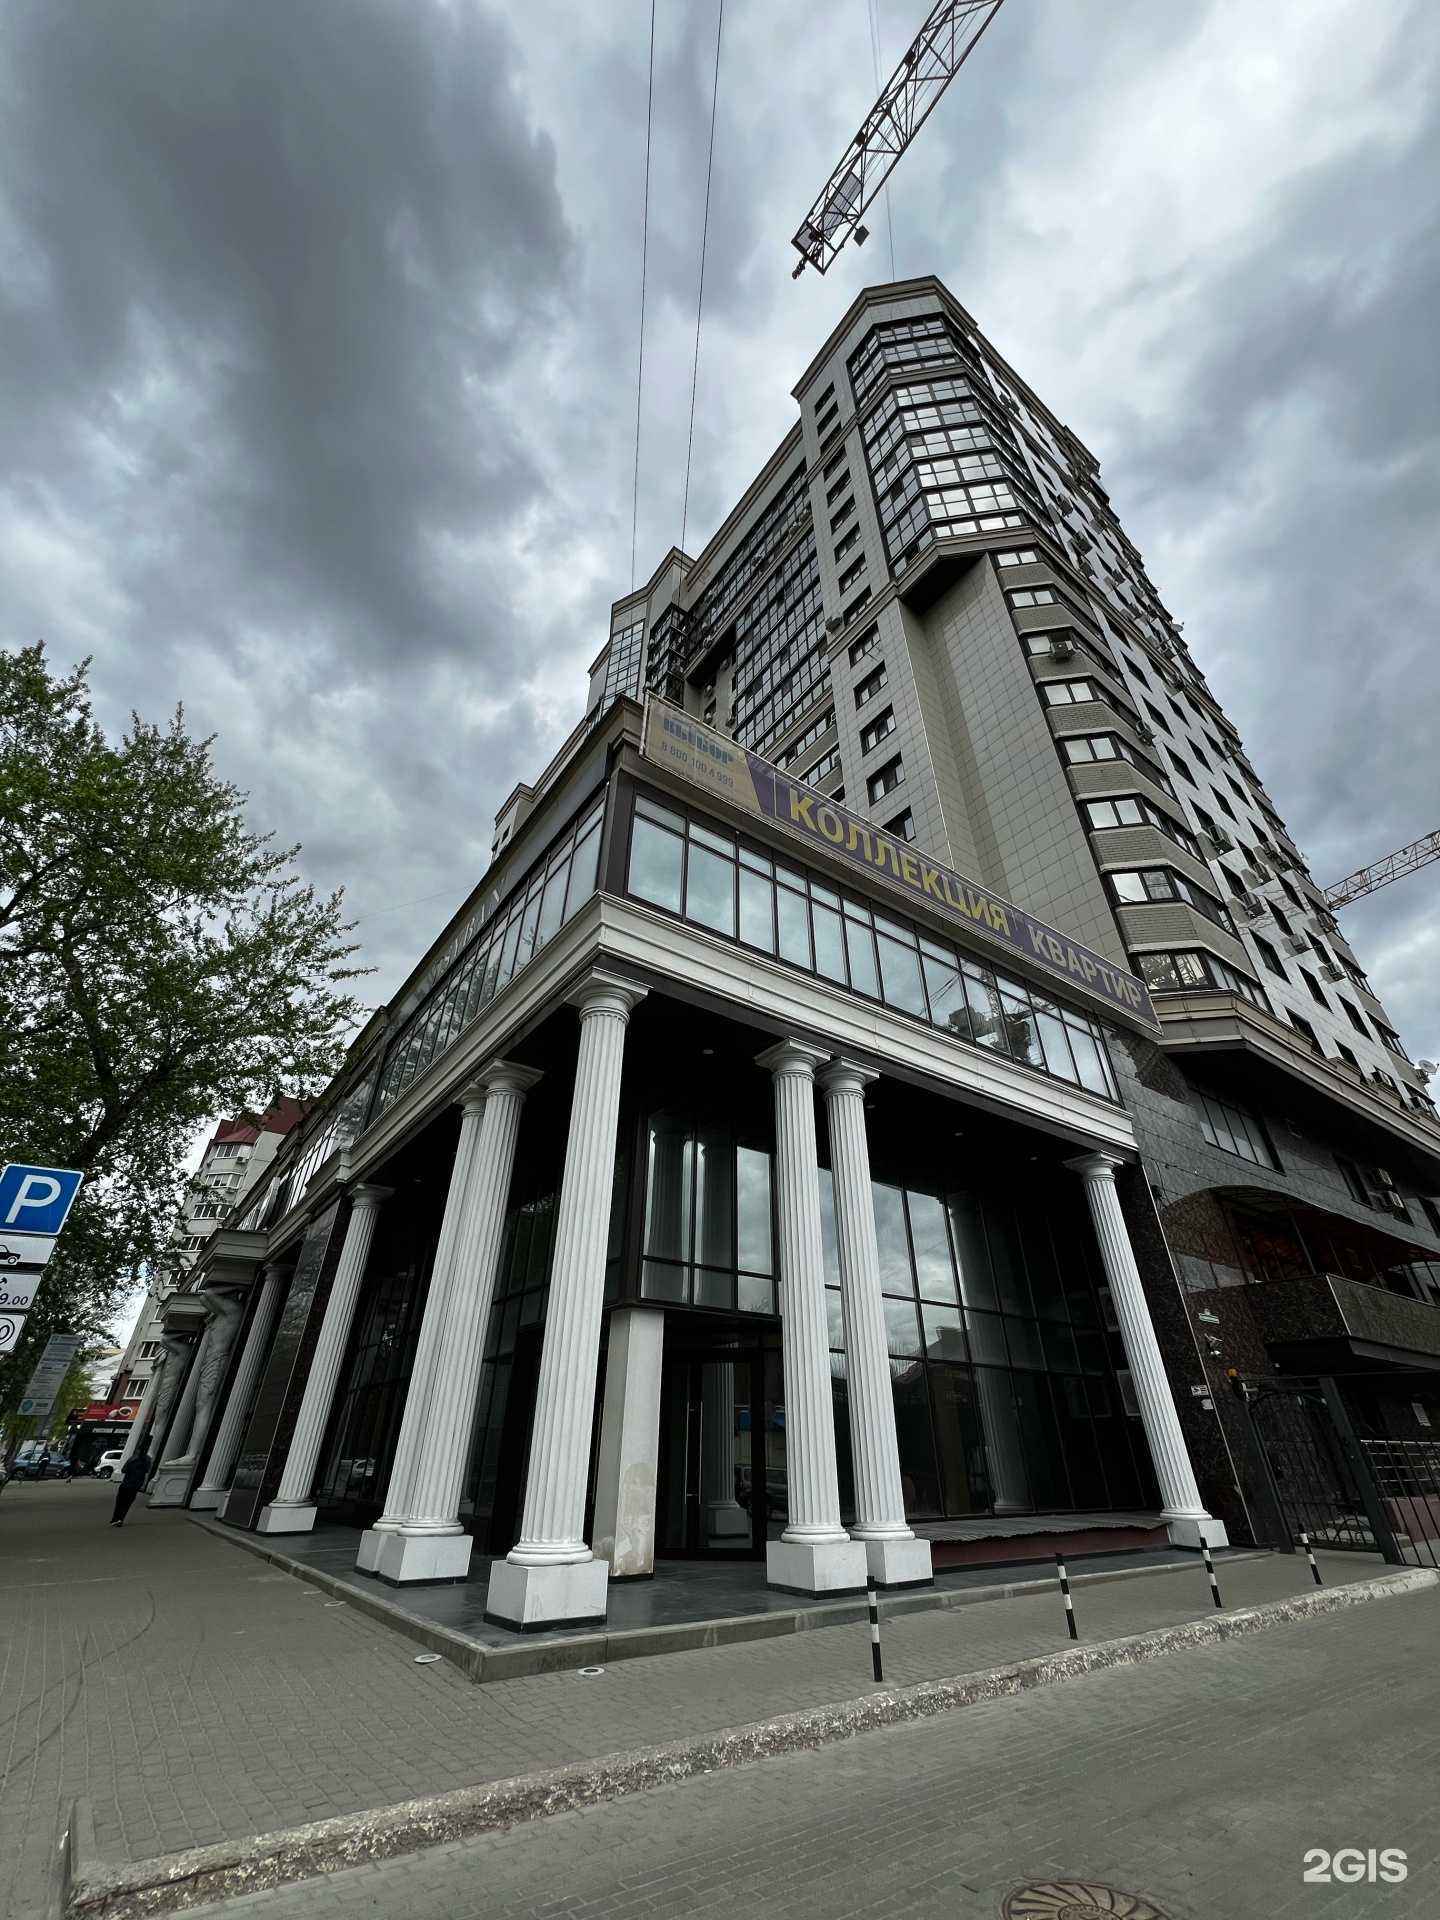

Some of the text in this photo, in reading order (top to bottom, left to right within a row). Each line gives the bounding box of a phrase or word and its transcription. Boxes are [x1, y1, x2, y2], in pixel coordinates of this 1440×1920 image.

[789, 784, 1142, 1009] КОЛЛЕКЦИЯ КВАРТИР
[5, 1174, 61, 1224] P
